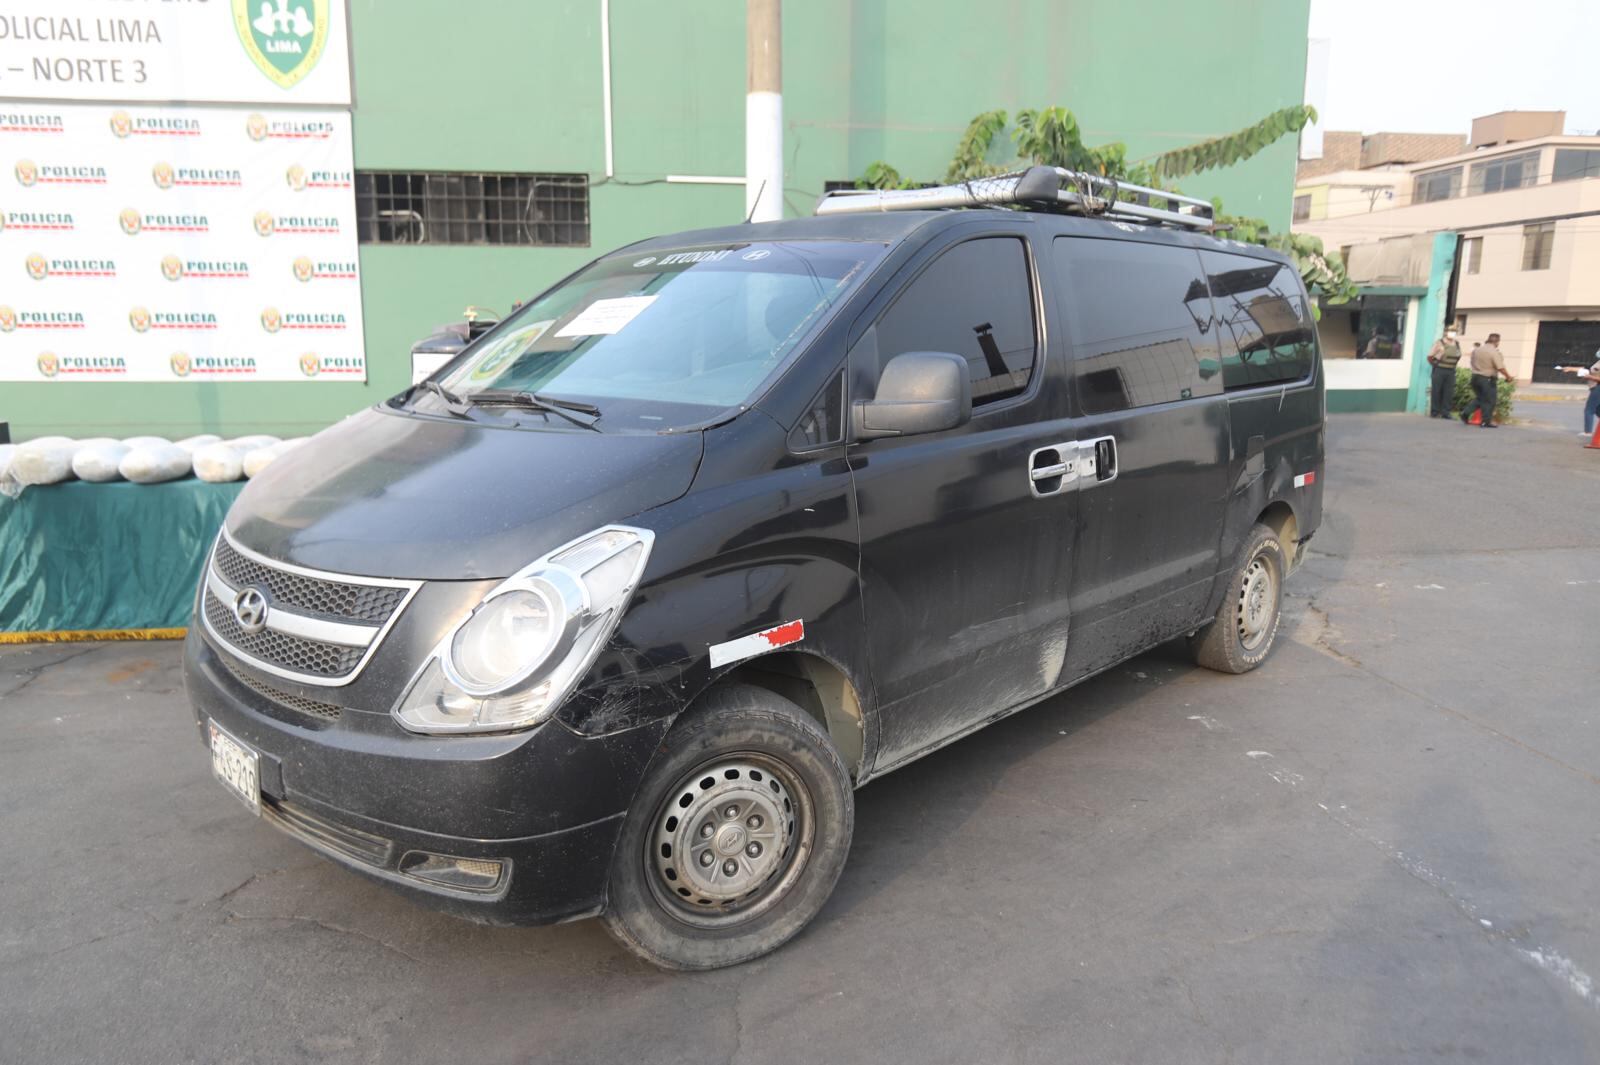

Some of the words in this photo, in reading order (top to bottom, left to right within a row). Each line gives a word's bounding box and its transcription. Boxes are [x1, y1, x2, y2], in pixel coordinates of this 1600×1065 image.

[97, 18, 162, 43] LIMA
[266, 40, 302, 53] LIMA
[32, 57, 125, 83] NORTE
[133, 60, 148, 83] 3
[136, 117, 200, 129] POLICIA
[41, 166, 107, 177] POLICIA
[178, 169, 241, 179] POLICIA
[8, 212, 74, 223] POLICIA
[145, 215, 208, 226] POLICIA
[278, 217, 339, 227] POLICIA
[51, 260, 116, 270] POLICIA
[186, 261, 248, 271] POLICIA
[20, 312, 84, 322] POLICIA
[155, 313, 217, 323] POLICIA
[285, 313, 346, 323] POLICIA
[63, 357, 126, 367] POLICIA
[195, 357, 256, 368] POLICIA
